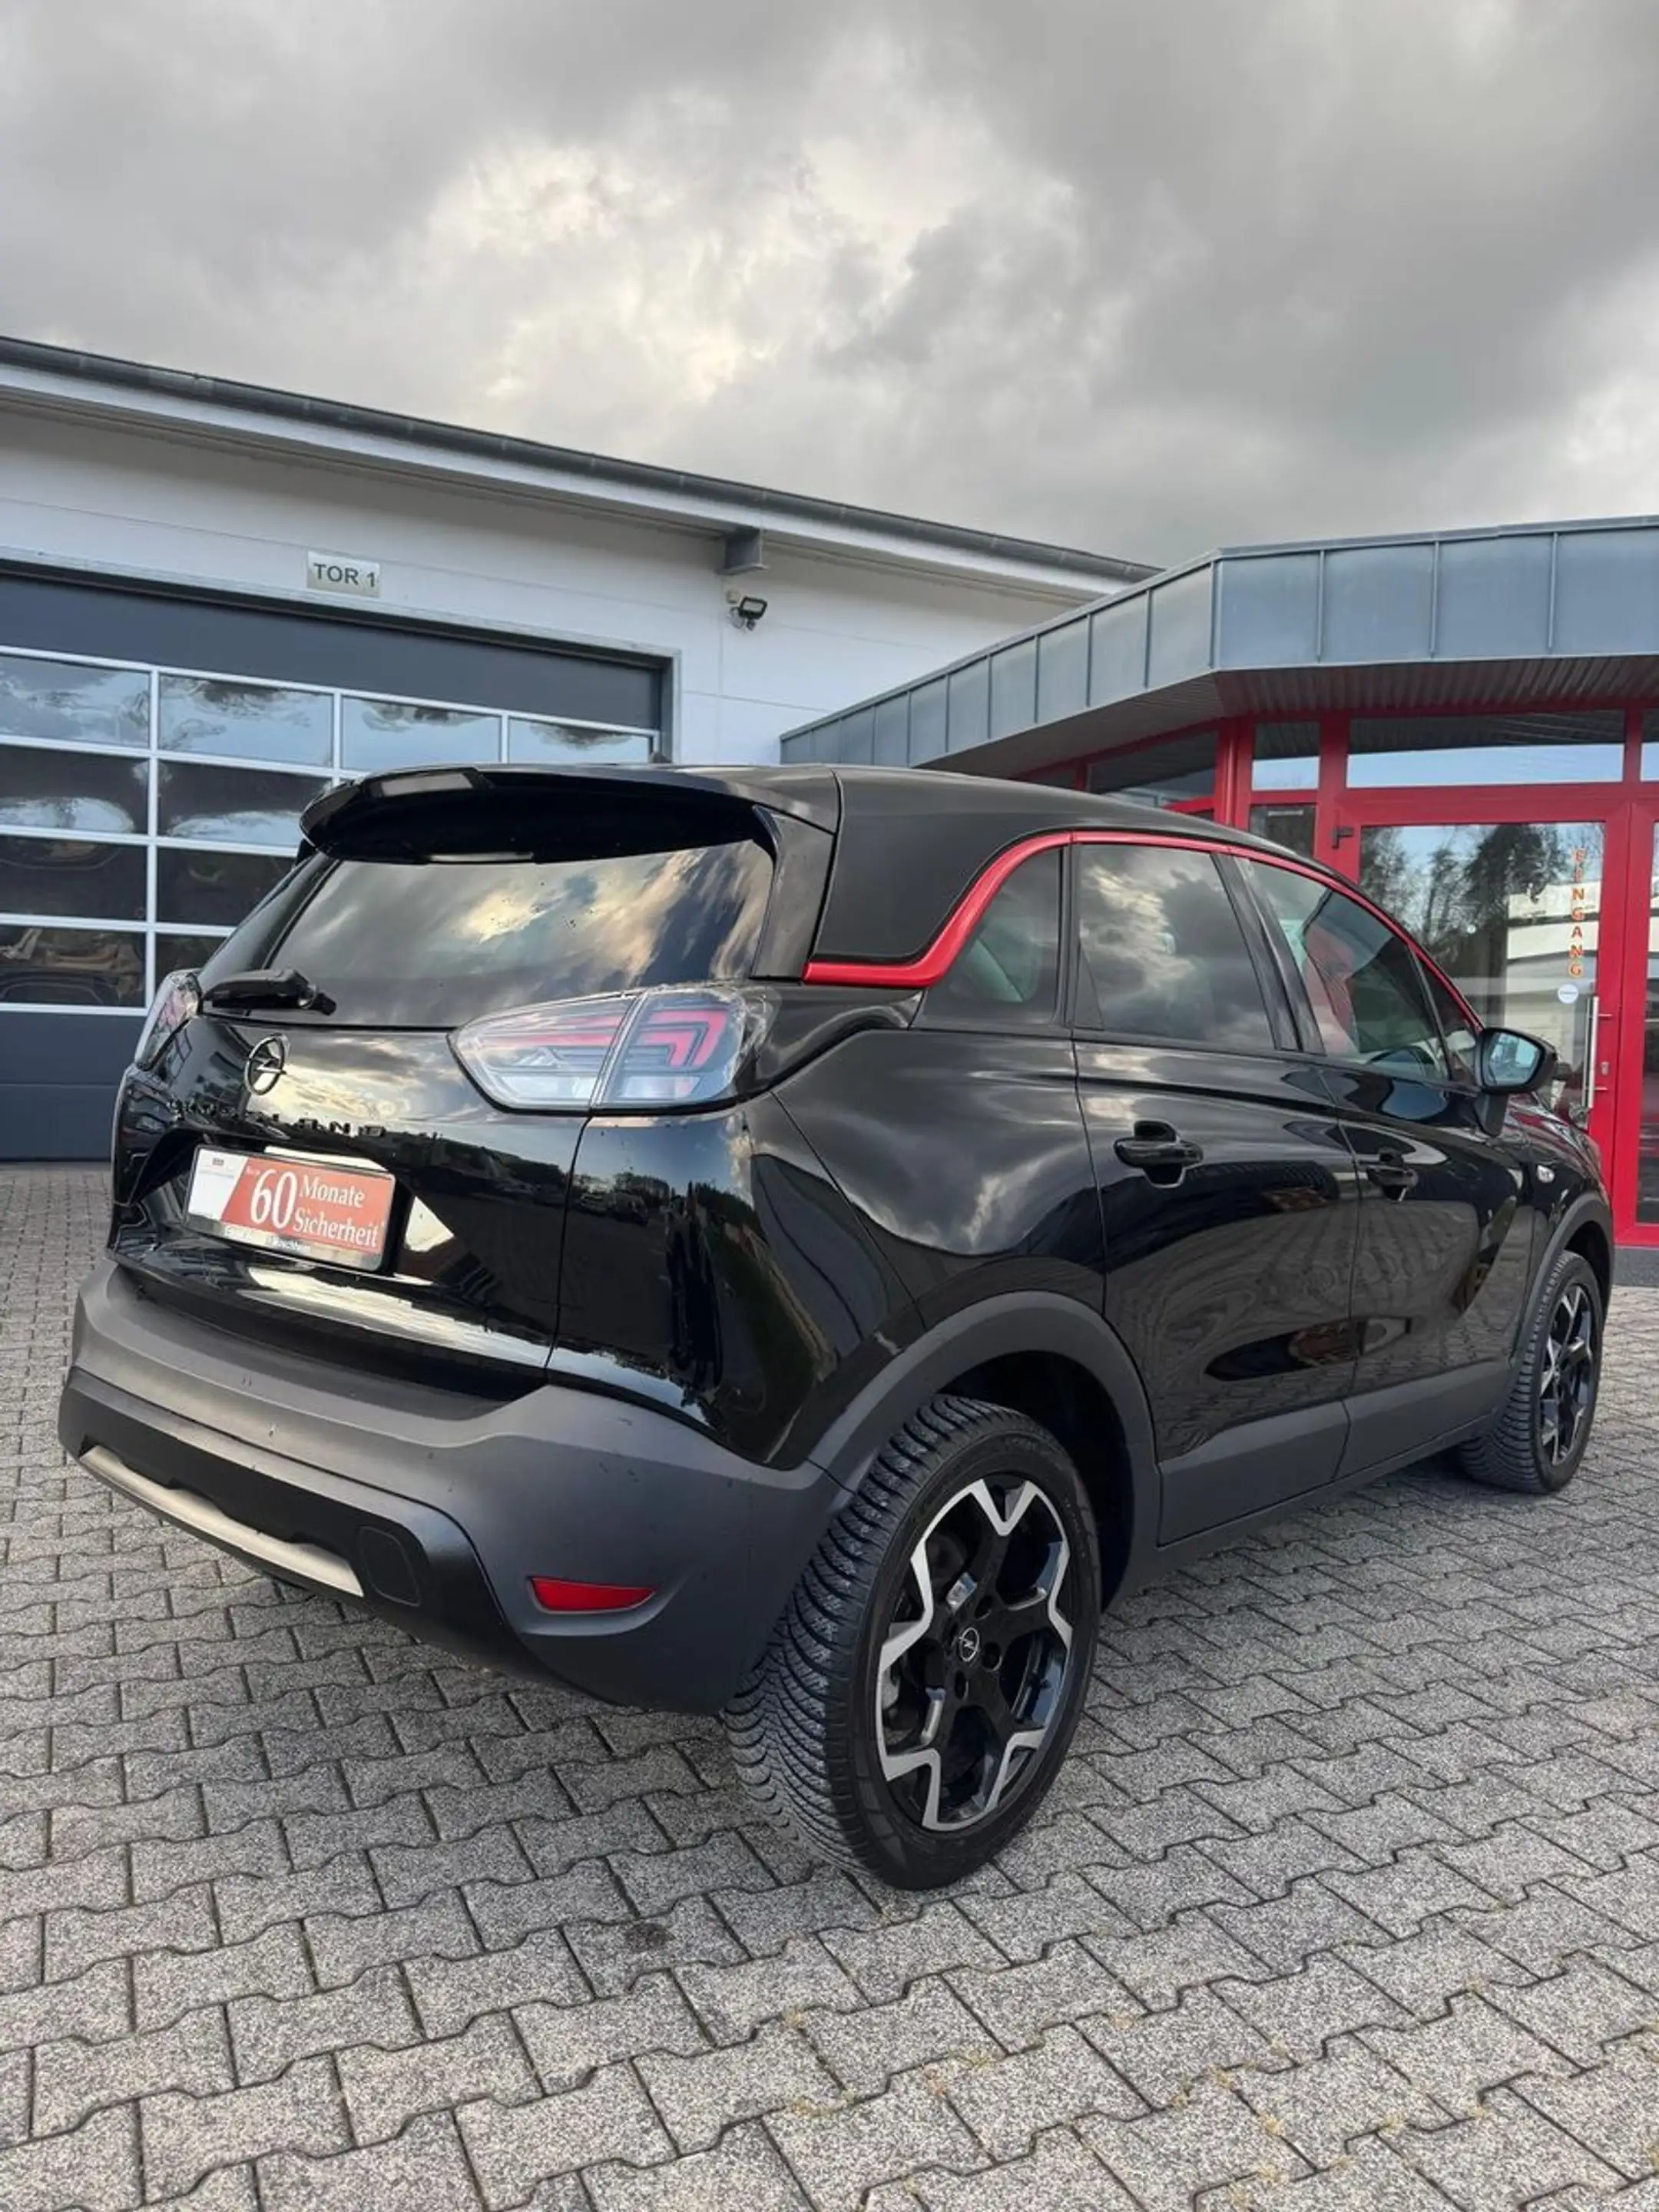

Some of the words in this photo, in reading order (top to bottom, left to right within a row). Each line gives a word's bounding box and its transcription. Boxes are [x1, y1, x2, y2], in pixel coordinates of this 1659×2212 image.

[313, 562, 359, 586] TOR
[366, 571, 376, 588] 1
[1569, 848, 1588, 976] EINGANG
[250, 1168, 297, 1229] 60
[300, 1174, 366, 1208] Monate
